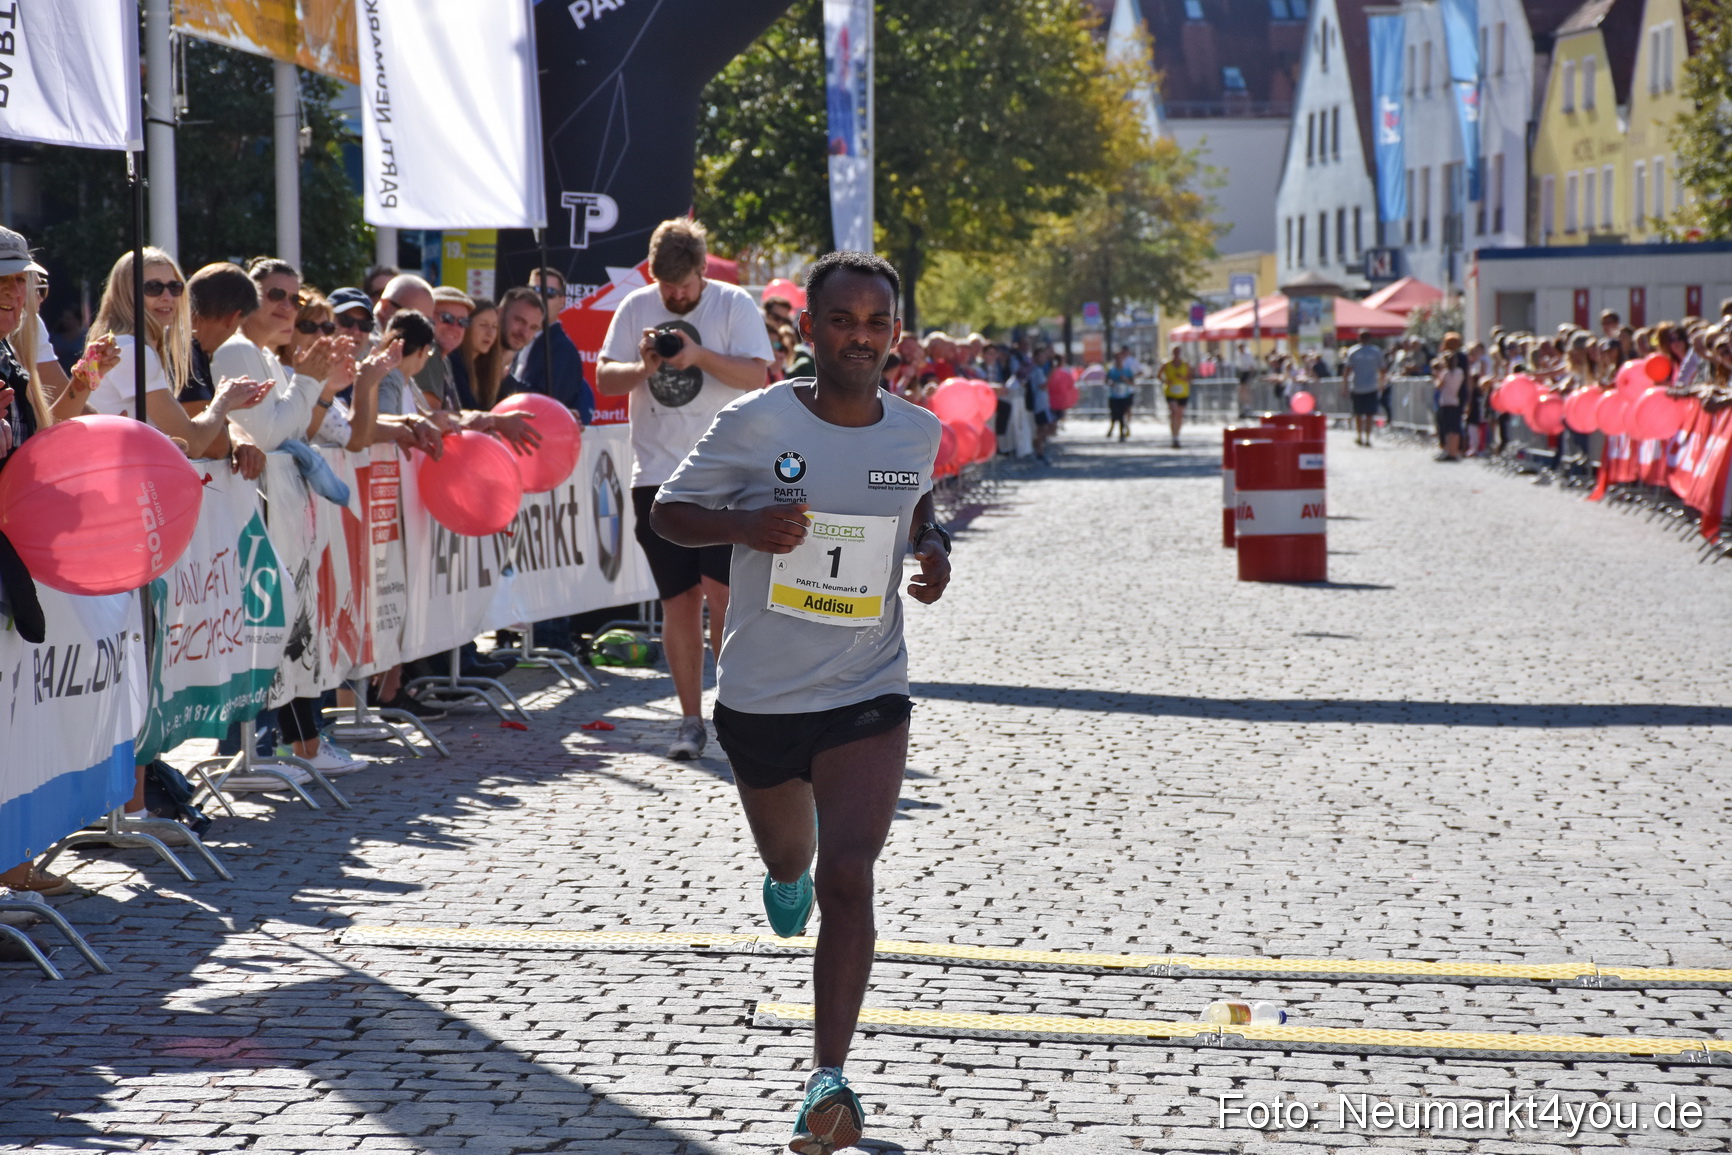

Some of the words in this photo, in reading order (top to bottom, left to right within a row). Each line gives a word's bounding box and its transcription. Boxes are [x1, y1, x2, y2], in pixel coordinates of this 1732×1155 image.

[568, 0, 625, 30] PA
[869, 471, 919, 485] BOCK
[774, 488, 807, 497] PARTL
[774, 496, 807, 504] Neumarkt
[813, 522, 865, 538] BOCK
[827, 546, 842, 578] 1
[796, 578, 821, 589] PARTL
[822, 583, 858, 593] Neumarkt
[803, 595, 854, 614] Addisu
